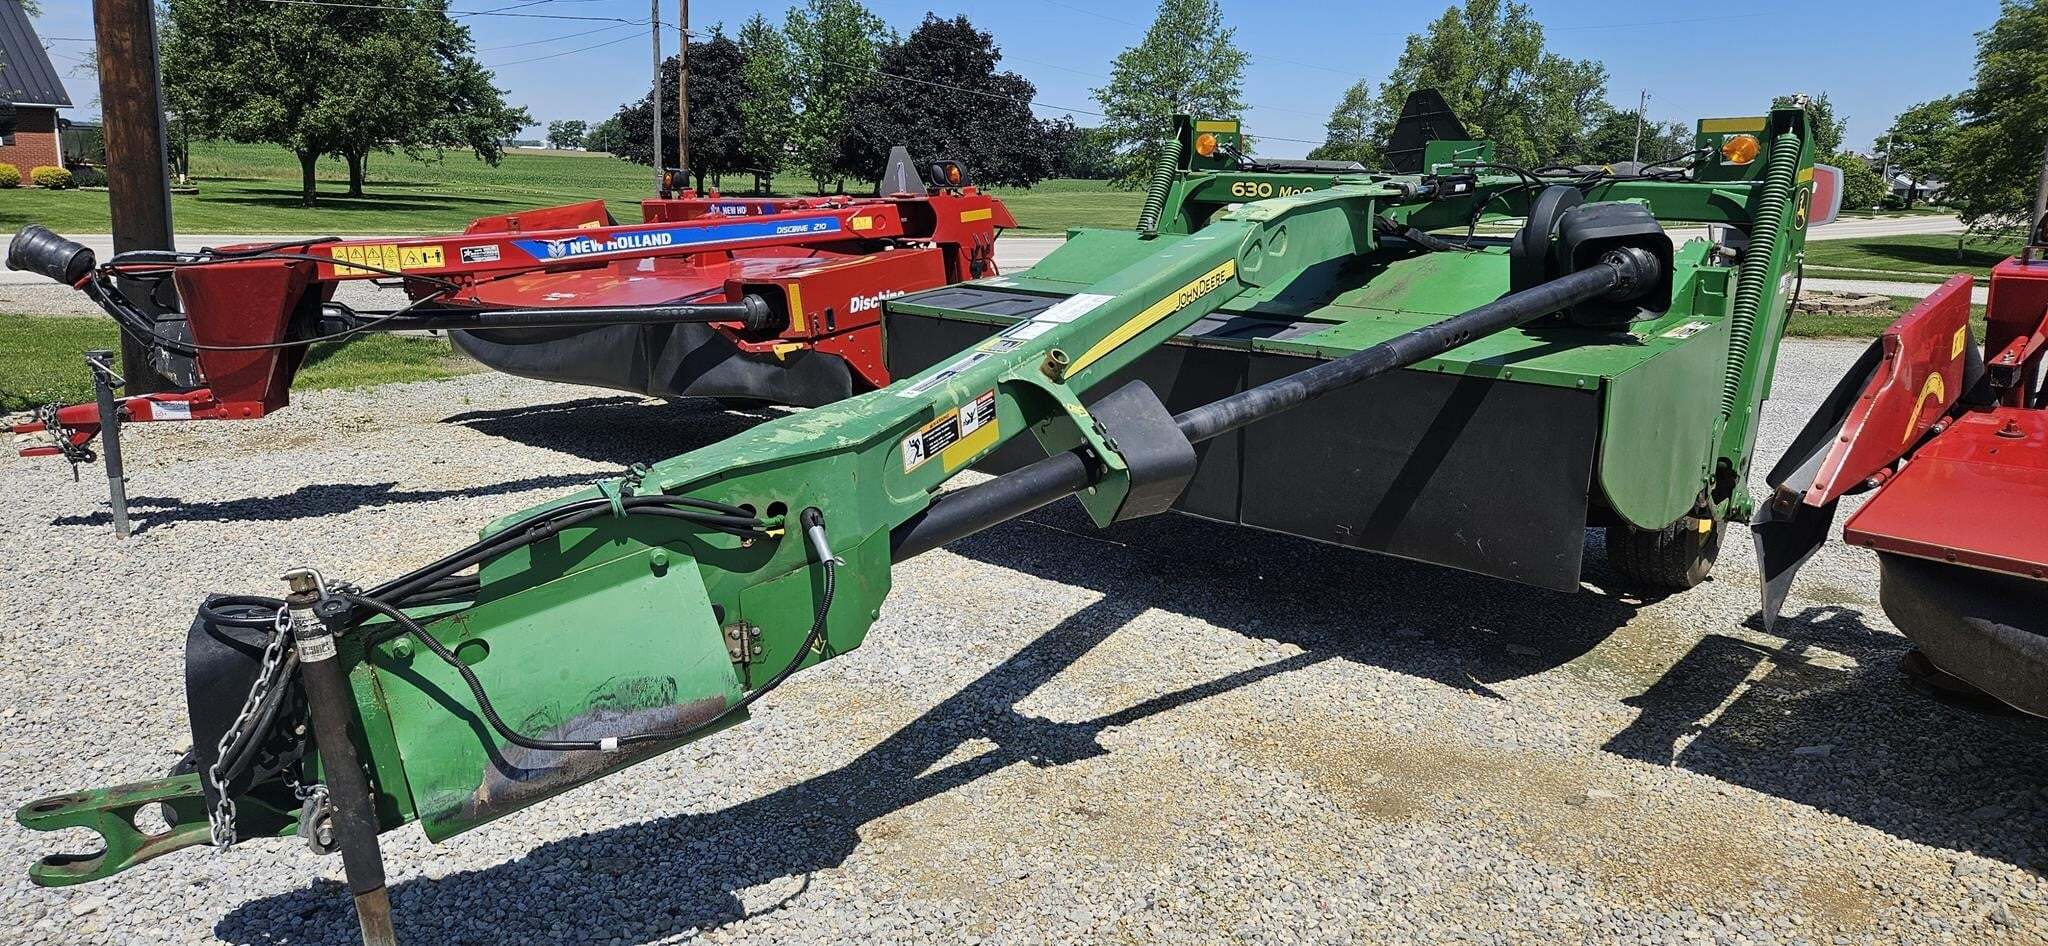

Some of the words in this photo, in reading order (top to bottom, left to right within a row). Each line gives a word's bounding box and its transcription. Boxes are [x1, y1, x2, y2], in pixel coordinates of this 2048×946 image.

[1231, 181, 1273, 198] 630
[813, 223, 827, 231] 210
[570, 239, 604, 255] NEW
[606, 232, 672, 251] HOLLAND
[1175, 286, 1199, 309] JOHN
[1199, 269, 1226, 296] DEERE
